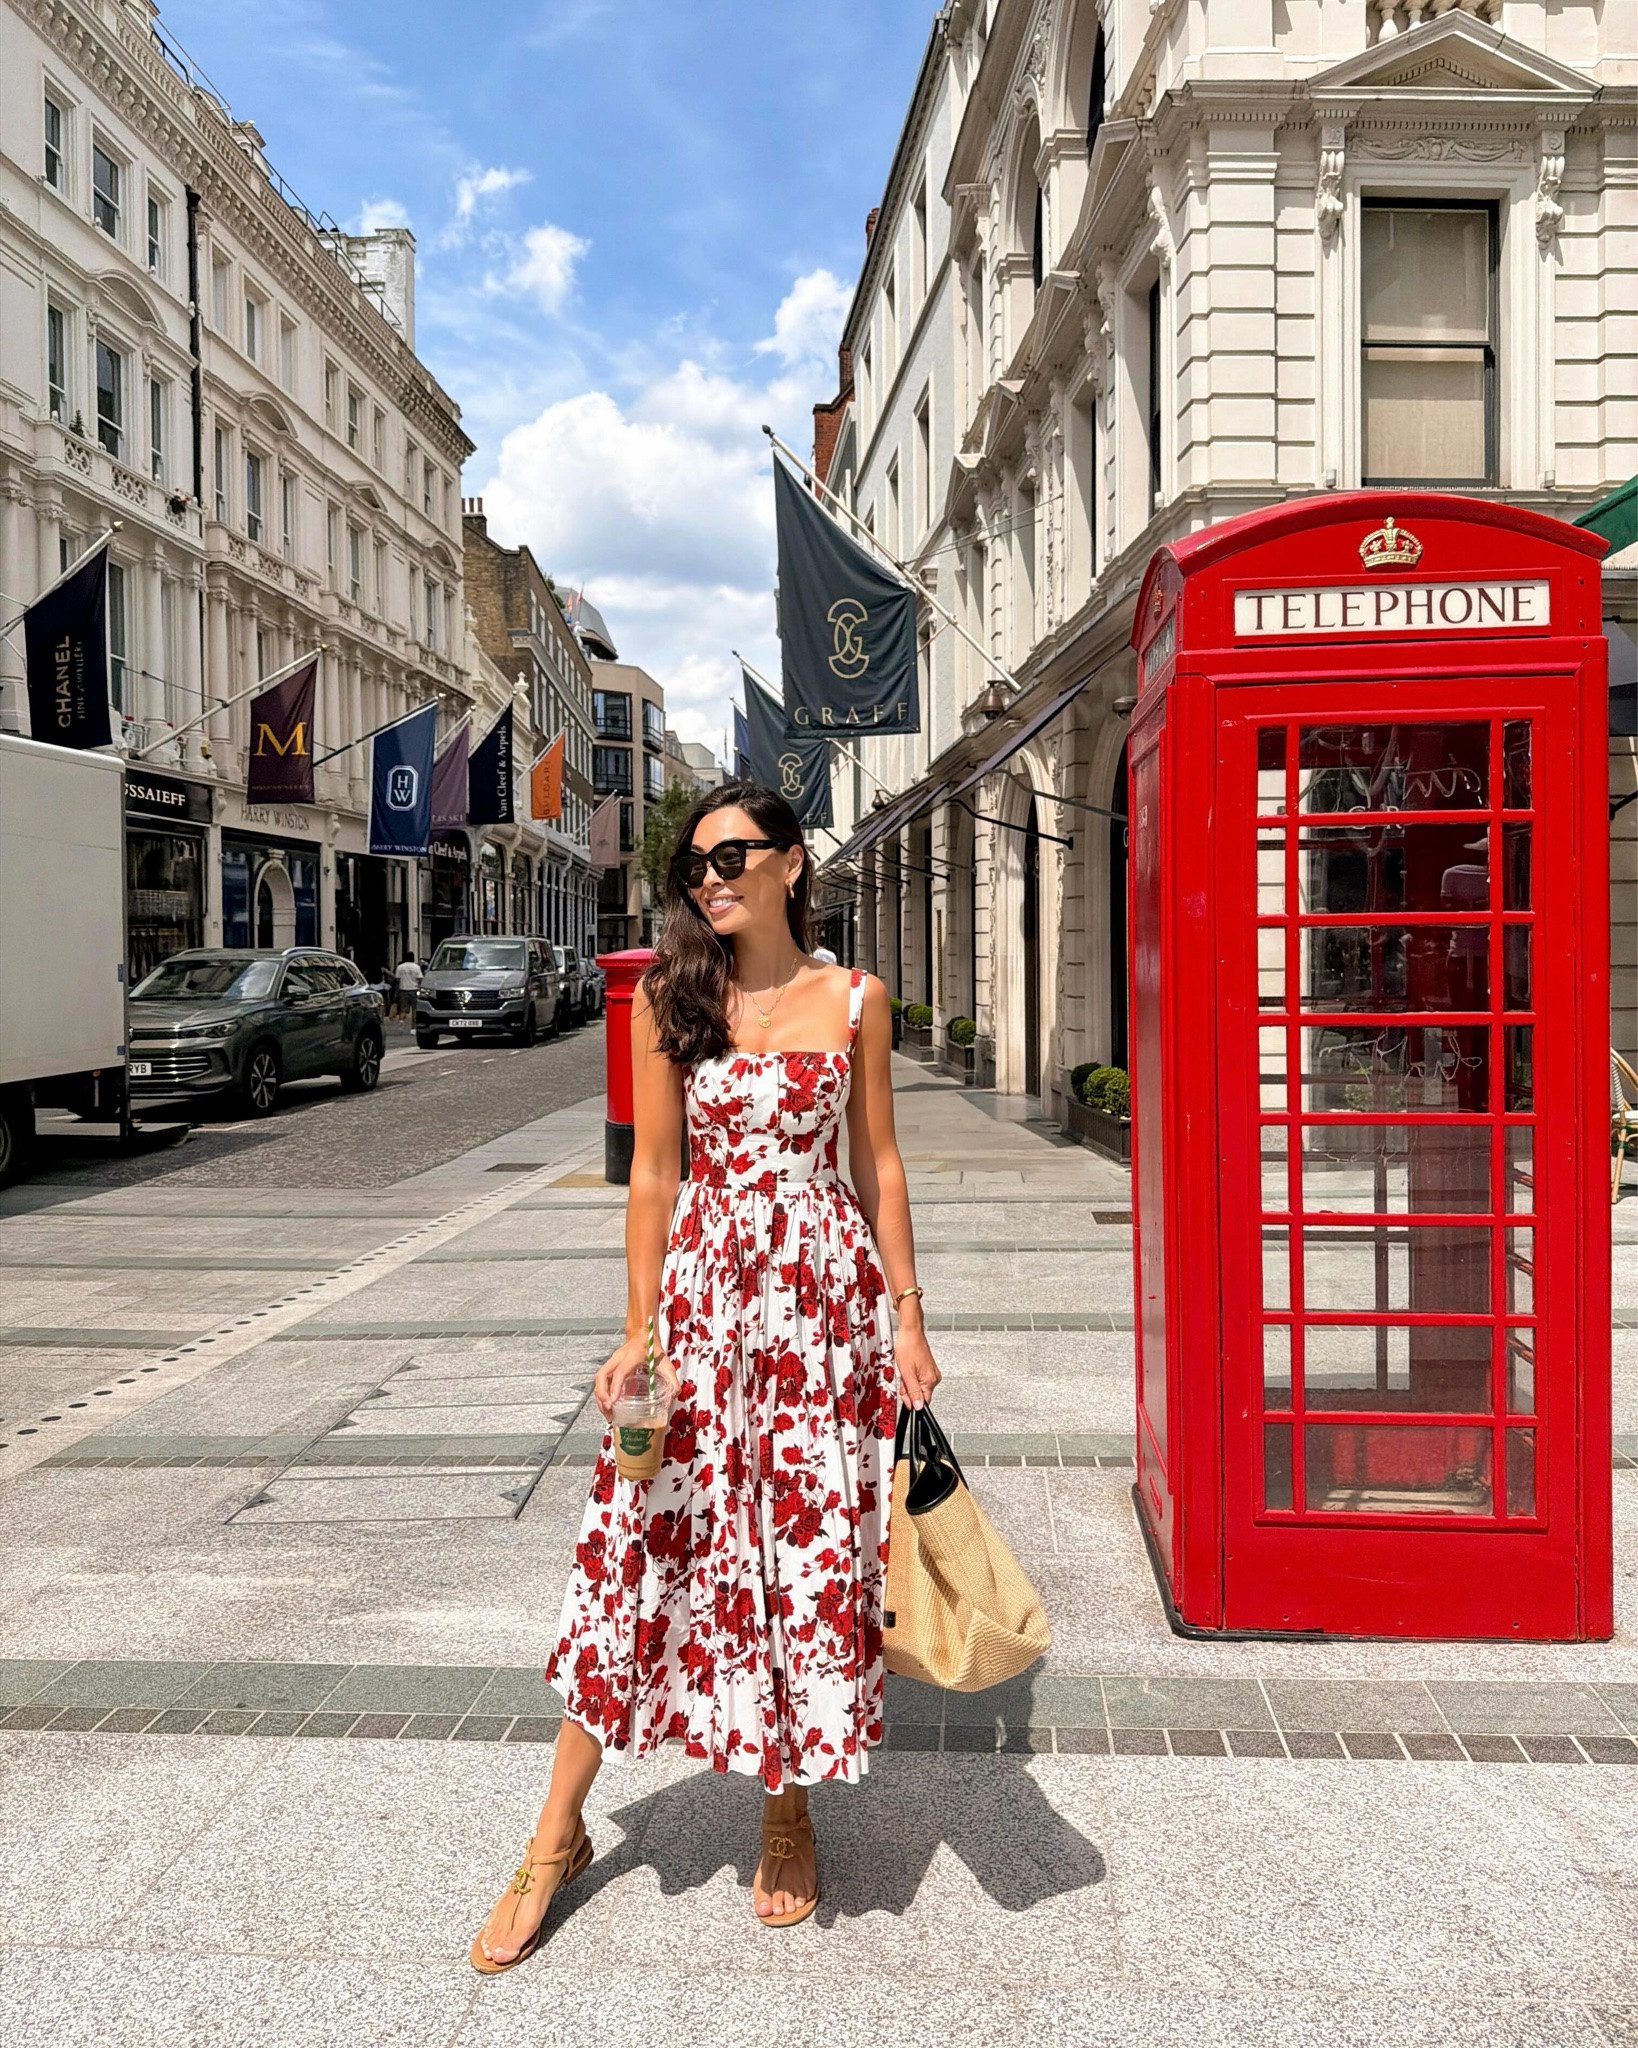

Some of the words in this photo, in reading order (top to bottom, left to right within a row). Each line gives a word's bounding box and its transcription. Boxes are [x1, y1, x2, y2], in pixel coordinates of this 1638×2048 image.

[1246, 586, 1536, 630] TELEPHONE
[55, 635, 72, 728] CHANEL
[794, 702, 908, 725] GRAFF
[253, 722, 310, 756] M
[497, 725, 509, 757] Arpels
[498, 760, 506, 768] &
[397, 775, 409, 789] H
[497, 769, 507, 797] Cleef
[393, 789, 411, 802] W
[241, 803, 270, 825] HARRY
[273, 809, 310, 832] WINSTON
[498, 799, 508, 819] Van
[394, 844, 427, 853] WINSTON
[129, 1063, 147, 1074] RYB
